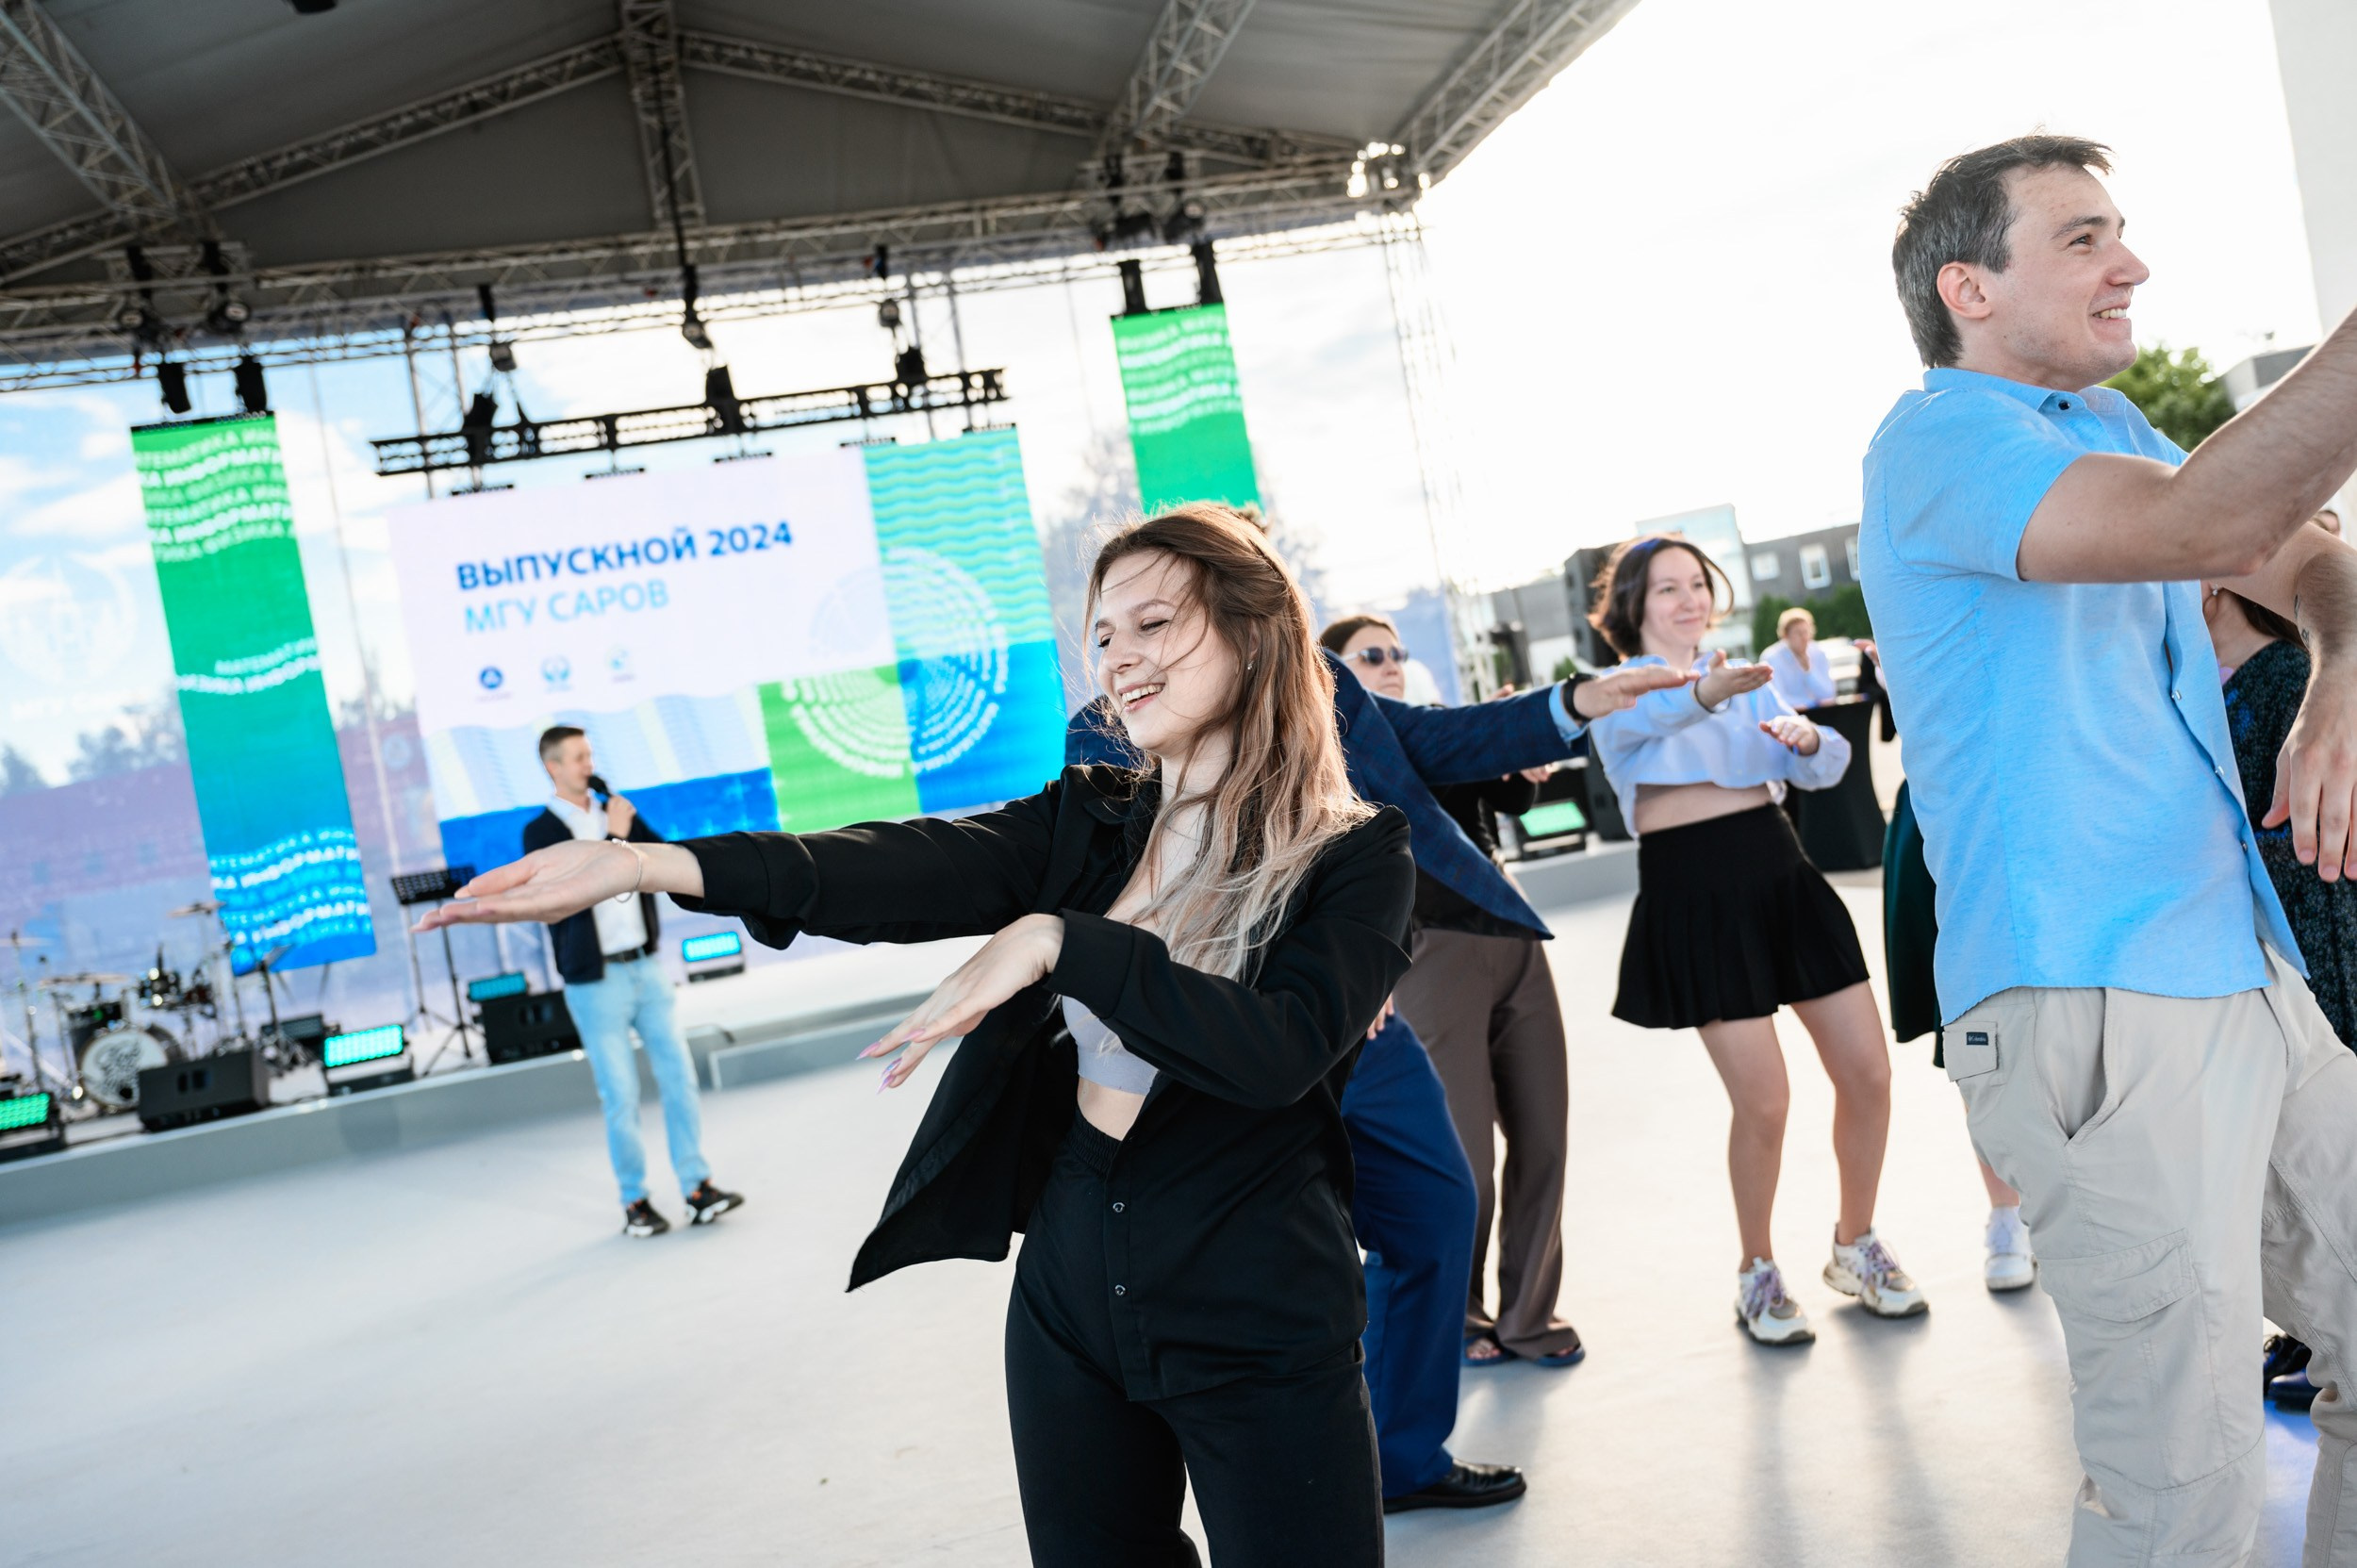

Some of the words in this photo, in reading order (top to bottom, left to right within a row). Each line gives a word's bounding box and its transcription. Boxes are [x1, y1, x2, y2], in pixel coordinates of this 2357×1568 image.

[456, 527, 697, 591] ВЫПУСКНОЙ
[706, 520, 794, 558] 2024
[464, 597, 537, 633] МГУ
[547, 579, 668, 622] САРОВ
